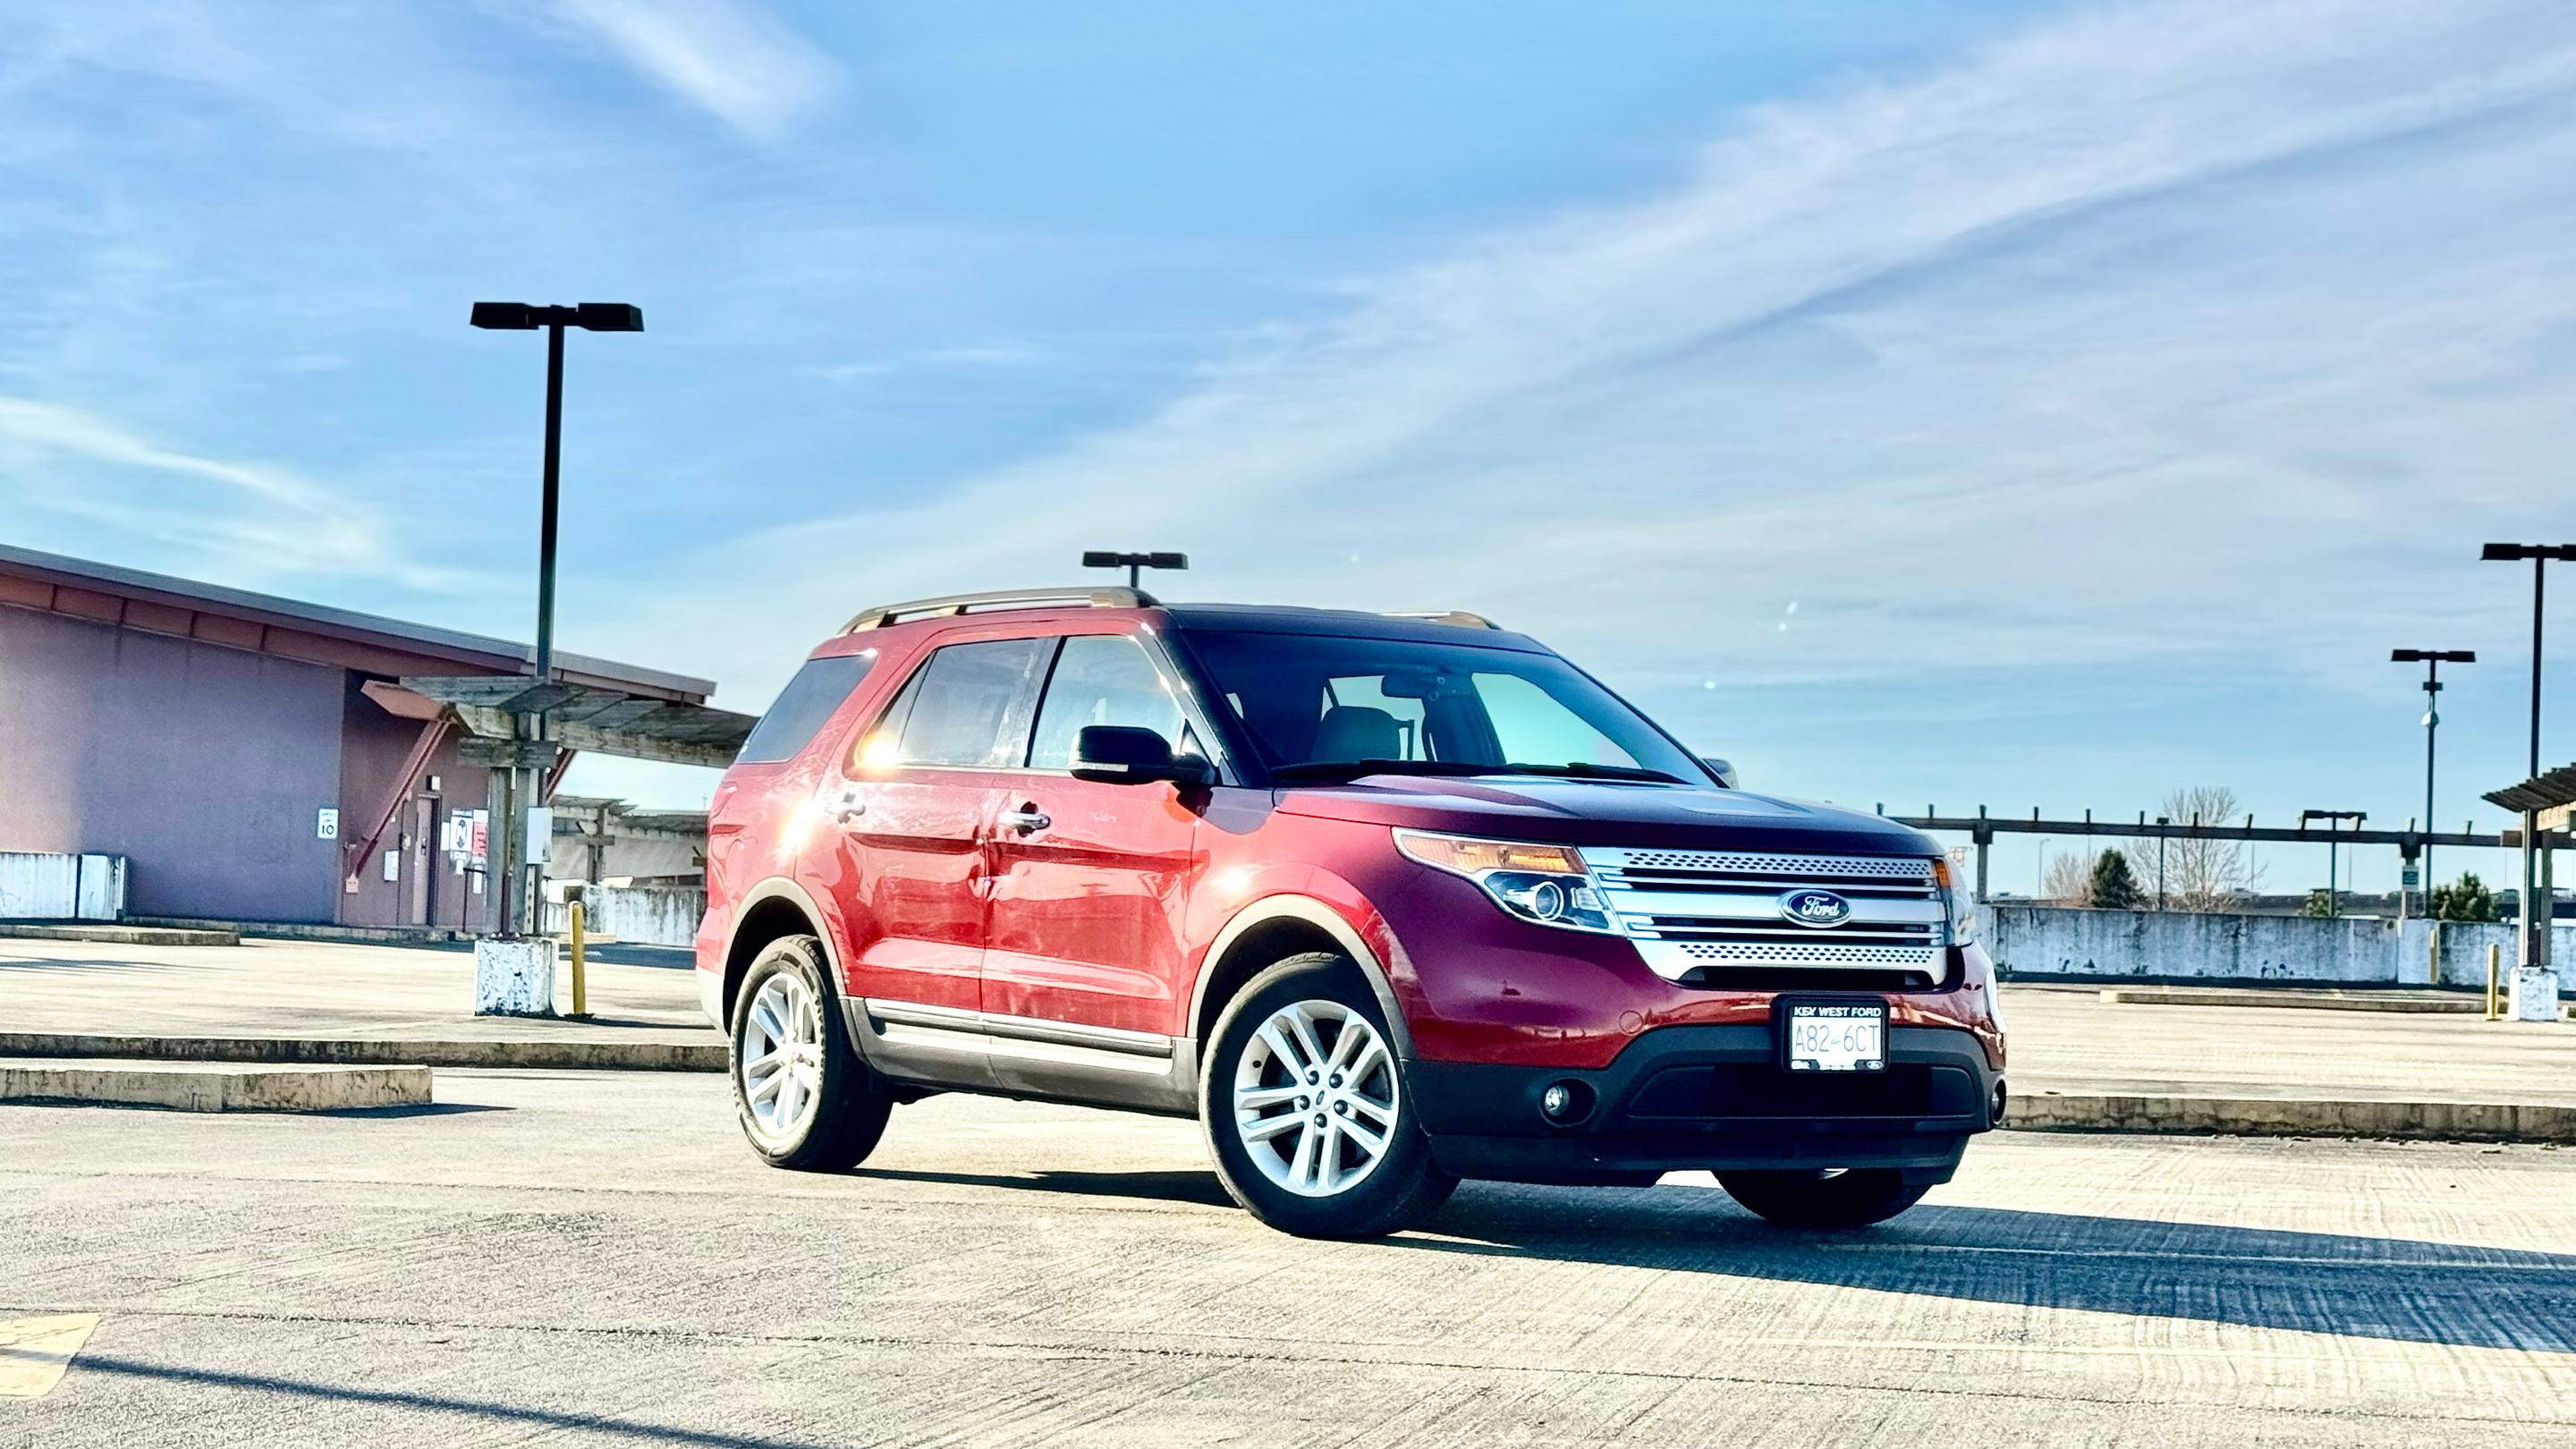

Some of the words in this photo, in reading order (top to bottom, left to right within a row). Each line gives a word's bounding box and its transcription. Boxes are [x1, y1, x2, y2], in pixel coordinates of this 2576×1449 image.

[321, 824, 335, 835] 10
[1801, 895, 1840, 916] Ford
[1794, 1007, 1817, 1016] KEY
[1818, 1007, 1851, 1016] WEST
[1851, 1007, 1882, 1017] FORD
